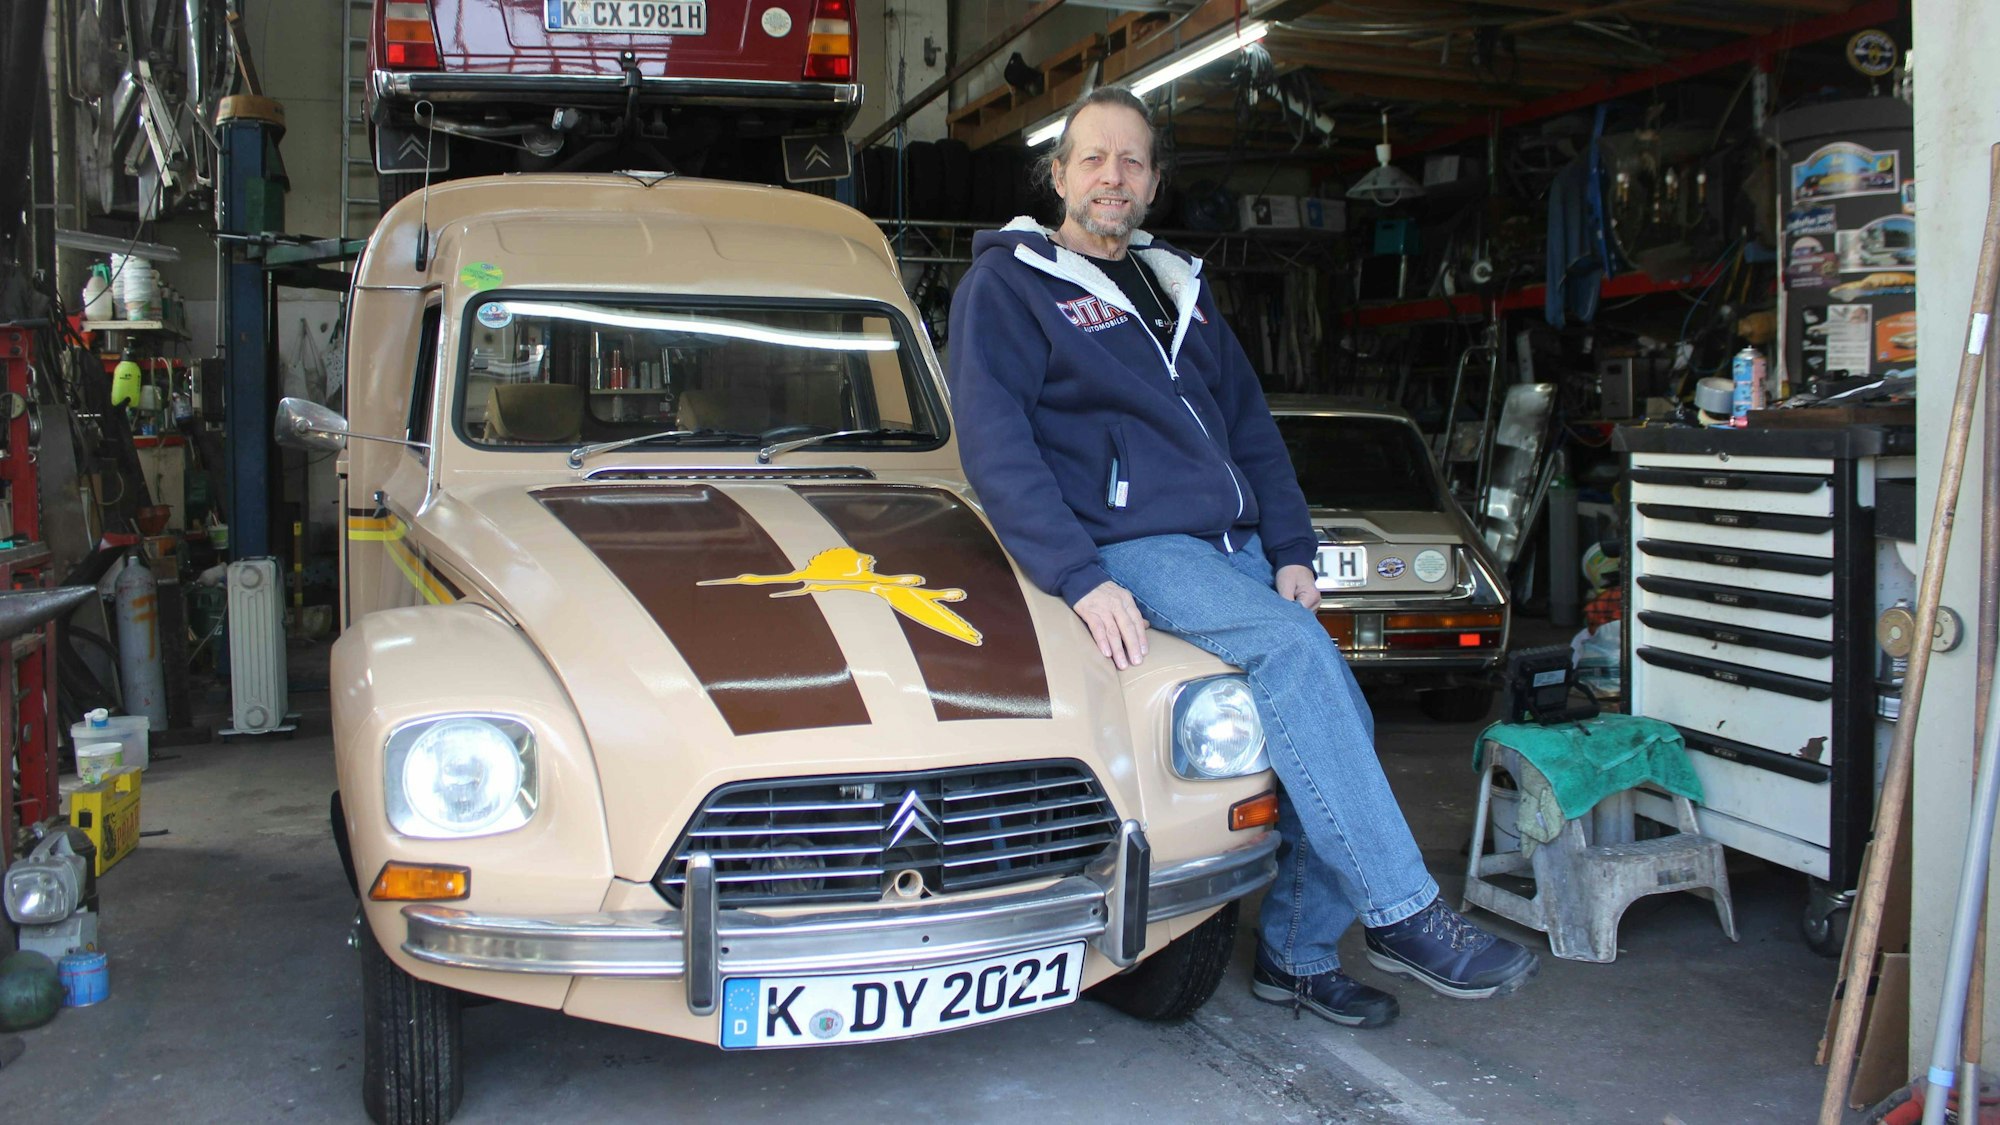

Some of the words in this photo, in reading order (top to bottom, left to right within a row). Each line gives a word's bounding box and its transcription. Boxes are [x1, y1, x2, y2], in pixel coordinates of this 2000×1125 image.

[563, 1, 577, 26] K
[594, 2, 622, 26] CX
[1056, 295, 1126, 326] CITR
[1084, 315, 1129, 333] AUTOMOBILES
[1339, 552, 1356, 577] H
[766, 985, 805, 1037] K
[850, 977, 928, 1033] DY
[940, 952, 1071, 1023] 2021
[734, 1020, 747, 1035] D
